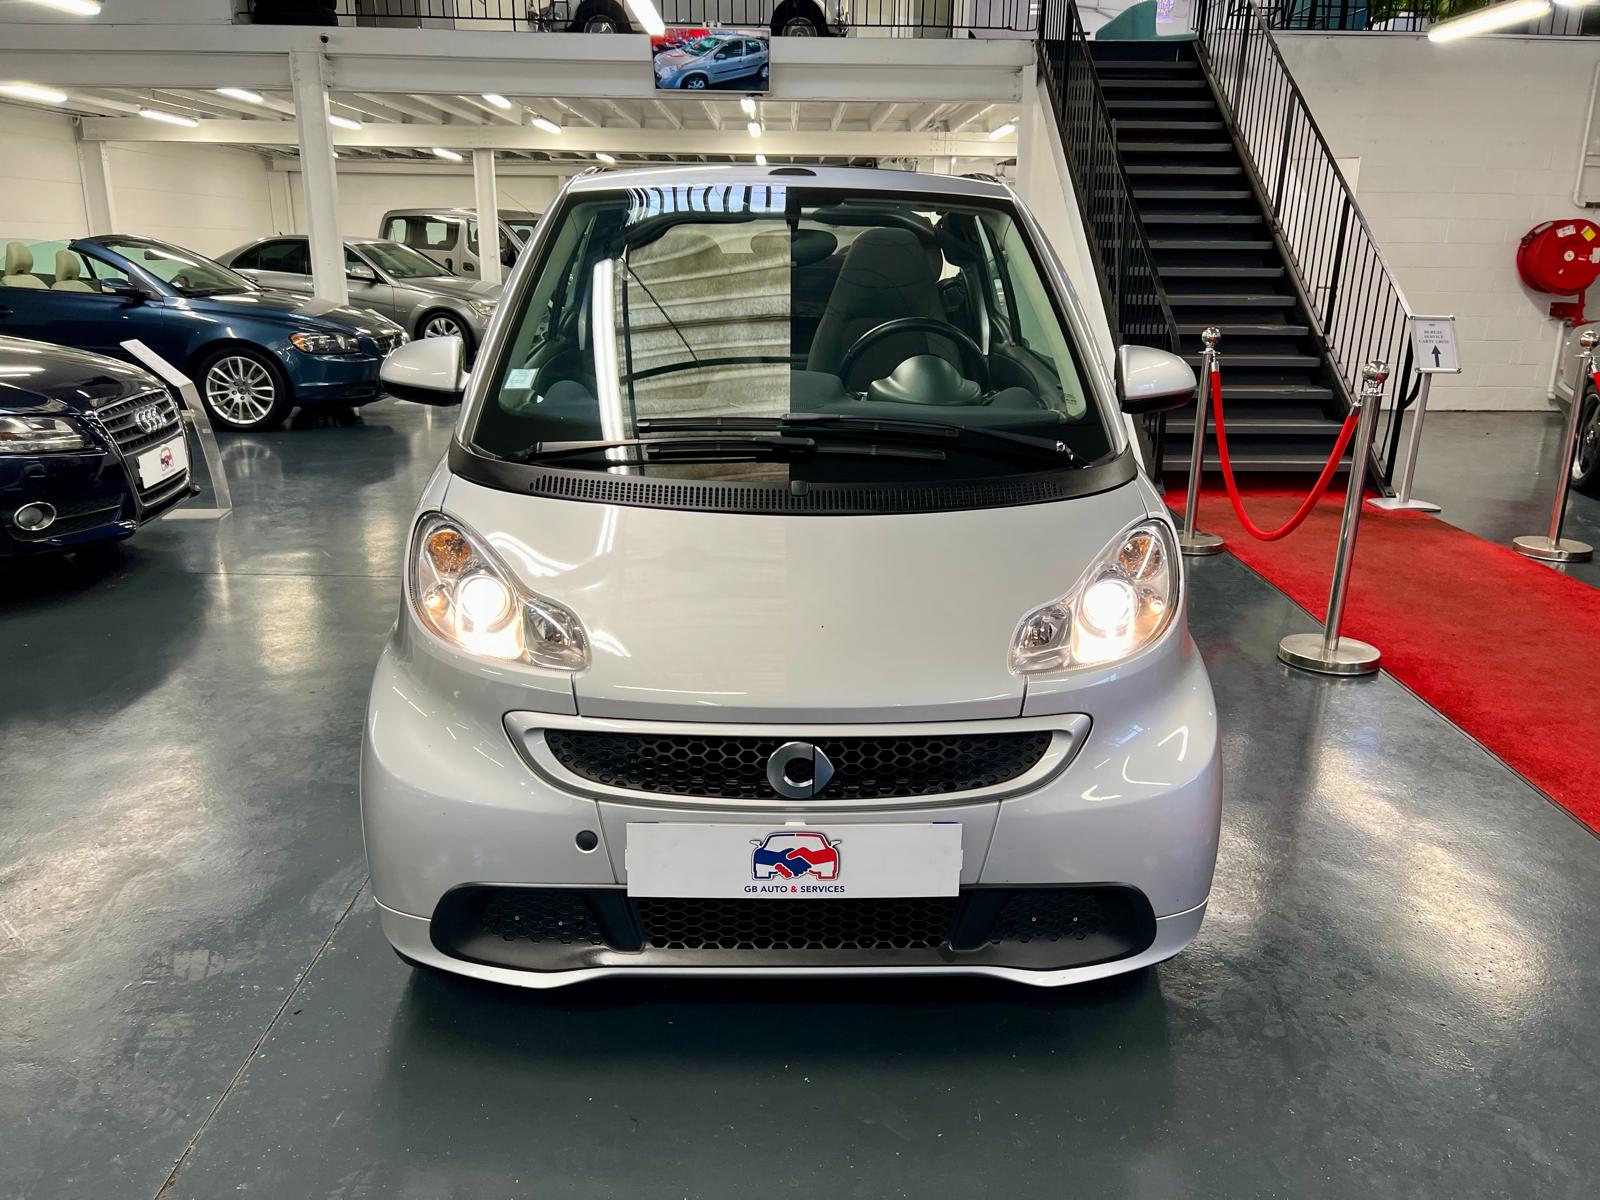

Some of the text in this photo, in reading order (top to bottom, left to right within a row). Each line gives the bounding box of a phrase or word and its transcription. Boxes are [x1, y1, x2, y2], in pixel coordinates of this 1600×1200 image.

[744, 885, 845, 893] GB AUTO & SERVICES
